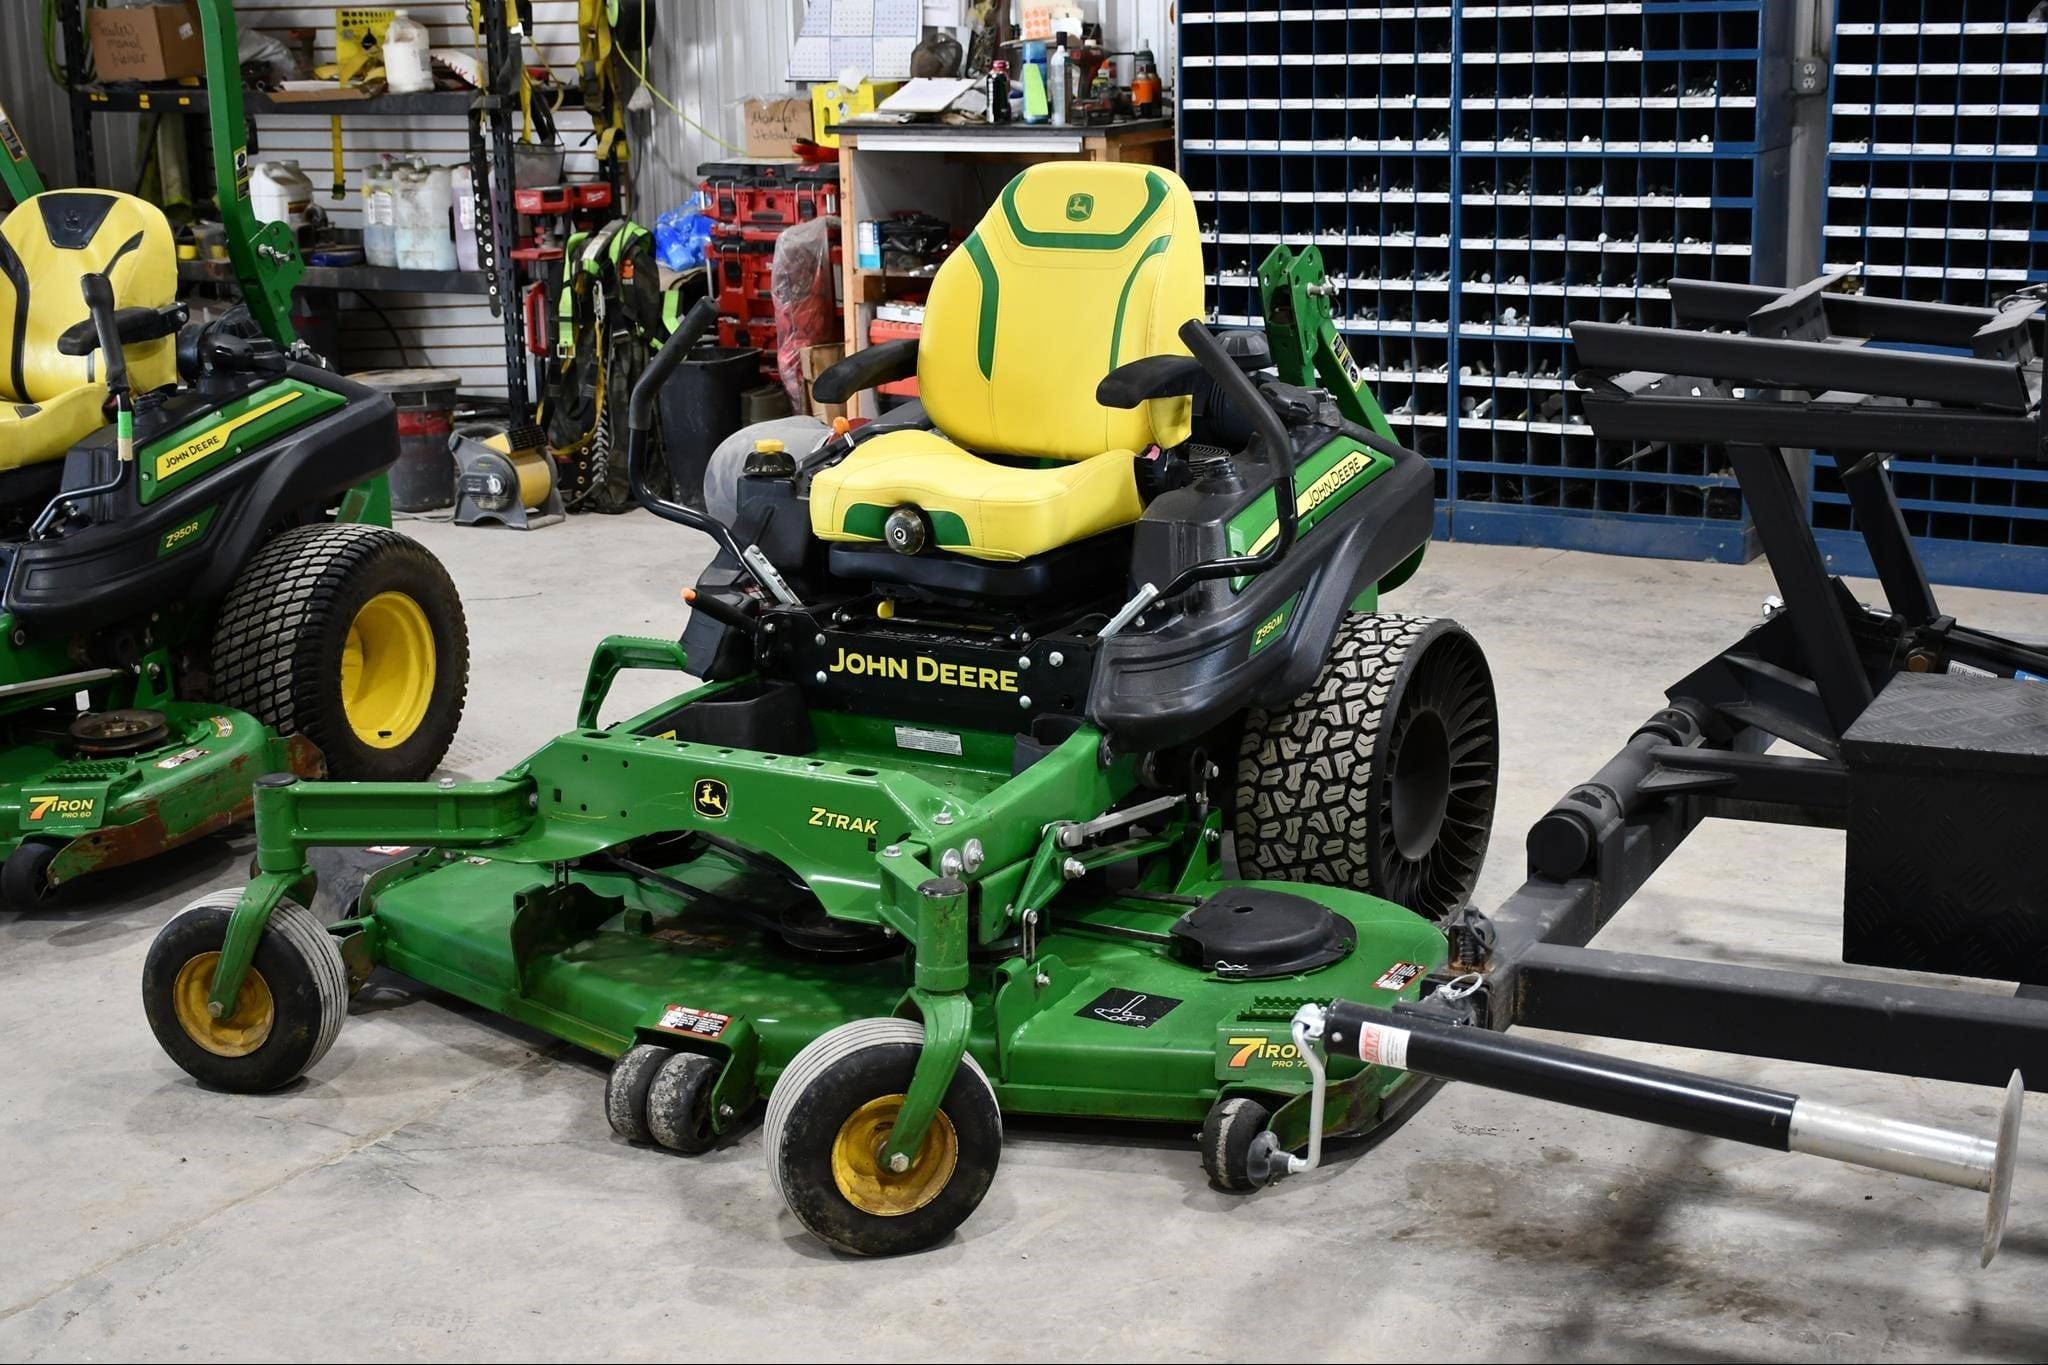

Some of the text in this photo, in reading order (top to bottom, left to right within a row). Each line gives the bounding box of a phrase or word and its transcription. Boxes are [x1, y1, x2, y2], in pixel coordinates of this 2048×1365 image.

[166, 435, 220, 469] JOHN DEERE
[1307, 457, 1361, 507] JOHN DEERE
[166, 521, 199, 548] Z950R
[1255, 613, 1284, 646] Z950M
[829, 647, 1019, 693] JOHN DEERE
[61, 811, 79, 819] PRO
[808, 806, 880, 835] ZTRAK
[1271, 1060, 1294, 1069] PRO
